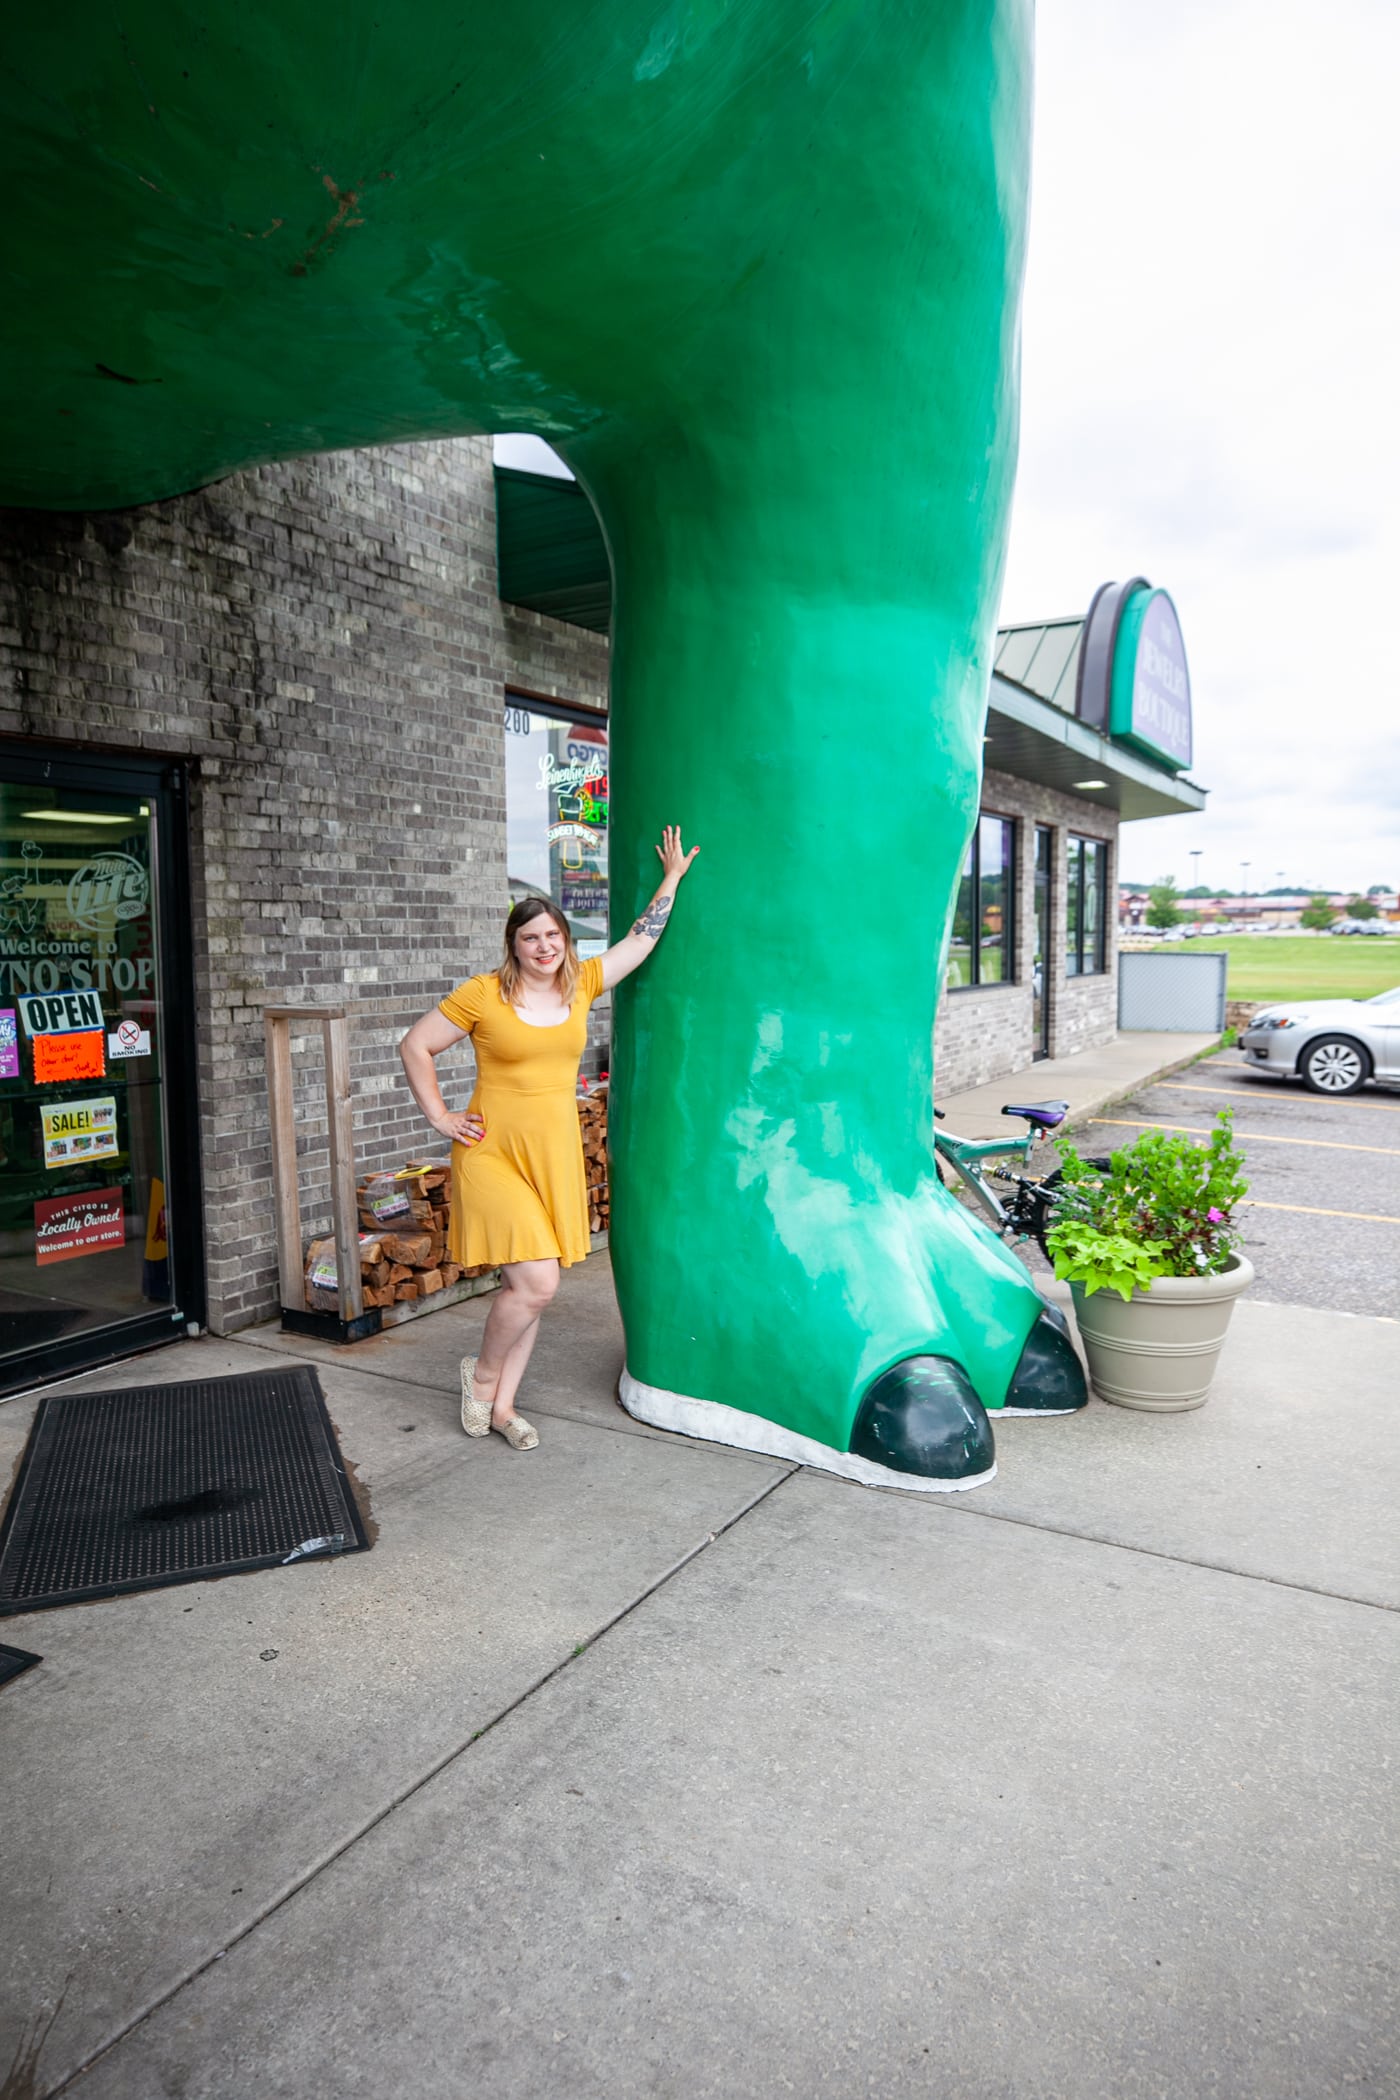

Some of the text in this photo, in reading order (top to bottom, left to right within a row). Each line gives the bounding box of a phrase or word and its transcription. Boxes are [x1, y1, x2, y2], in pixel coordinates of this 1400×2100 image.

[74, 872, 146, 917] Lite
[0, 938, 118, 955] Welcome to
[70, 957, 155, 993] STOP
[27, 994, 99, 1032] OPEN
[112, 1048, 148, 1057] SMOKING
[52, 1110, 90, 1133] SALE!
[37, 1207, 120, 1237] Locally Owned
[50, 1208, 70, 1221] THIS
[72, 1203, 97, 1213] CITGO
[38, 1230, 122, 1254] Welcome to our store.
